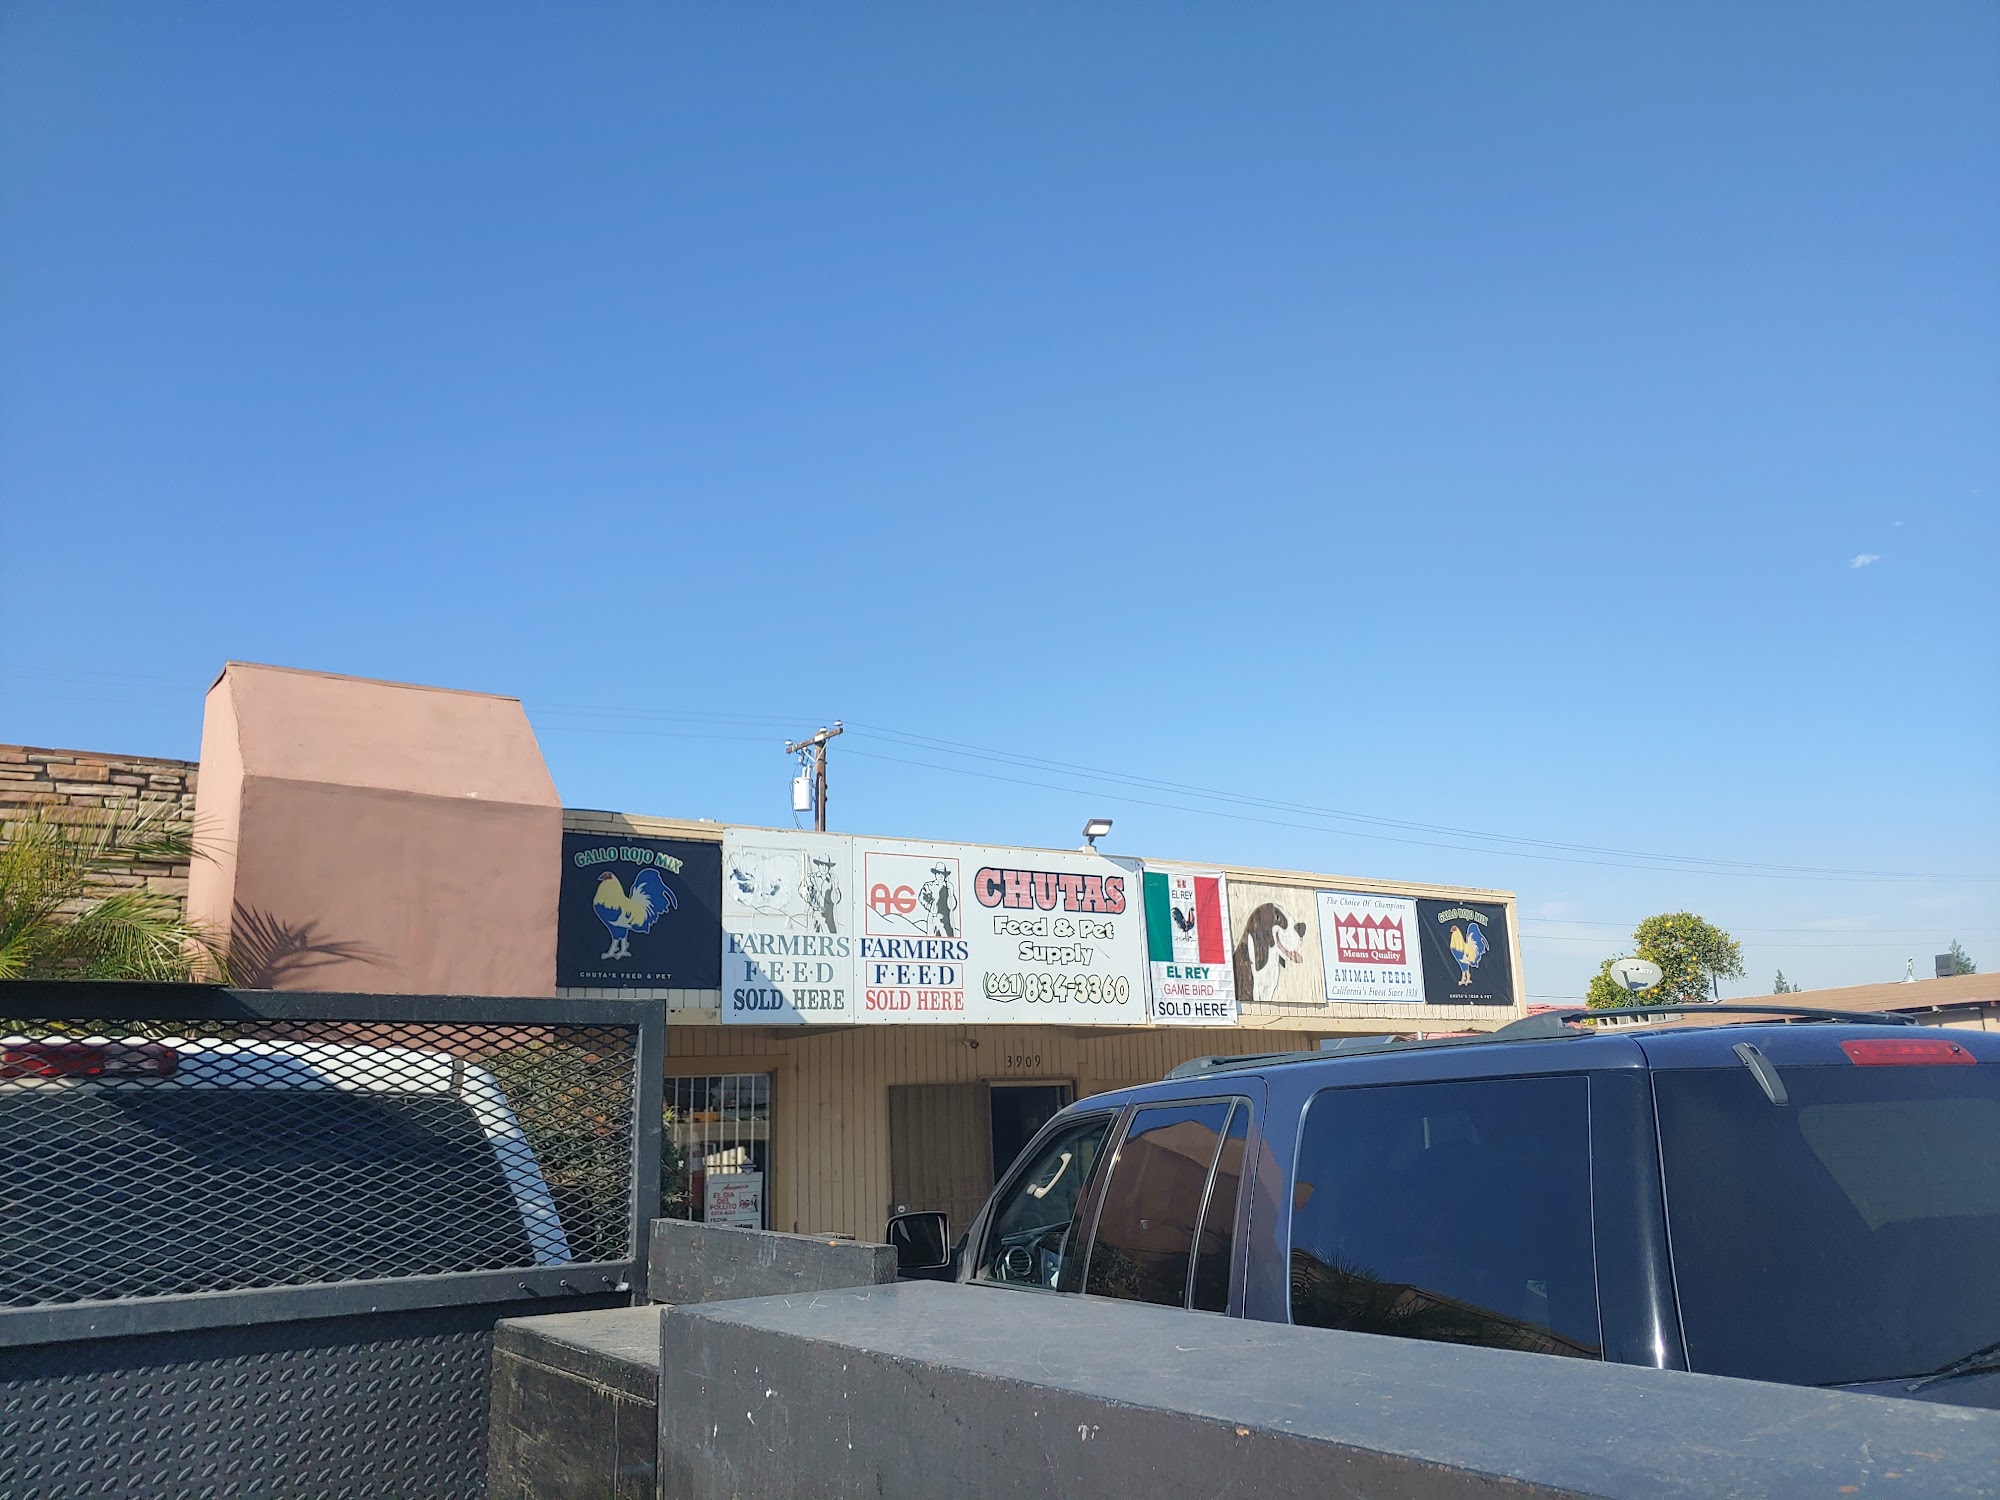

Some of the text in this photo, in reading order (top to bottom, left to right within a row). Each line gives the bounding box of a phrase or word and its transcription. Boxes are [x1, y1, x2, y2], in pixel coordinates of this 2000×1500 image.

[574, 846, 683, 874] GALLO ROJO MIX
[870, 883, 917, 914] AG
[974, 866, 1126, 915] CHUTAS
[1171, 889, 1193, 900] EL REY
[1326, 897, 1406, 911] The Choice Of Champions
[1437, 908, 1489, 926] GALLO ROJO MIX
[993, 916, 1114, 940] Feed & Pet
[728, 932, 850, 958] FARMERS
[1338, 926, 1402, 951] KING
[859, 937, 969, 961] FARMERS
[1018, 941, 1093, 966] Supply
[1343, 949, 1401, 961] Means Quality
[580, 971, 617, 979] CHUTA'S
[1166, 965, 1210, 979] EL REY
[1335, 969, 1412, 984] ANIMAL FEEDS
[1164, 983, 1214, 996] GAME BIRD
[1332, 985, 1367, 996] California's
[1368, 987, 1386, 997] Finest
[1388, 987, 1403, 997] Since
[733, 988, 845, 1010] SOLD HERE
[865, 989, 964, 1011] SOLD HERE
[1158, 1001, 1228, 1016] SOLD HERE
[1007, 1055, 1041, 1068] 3909
